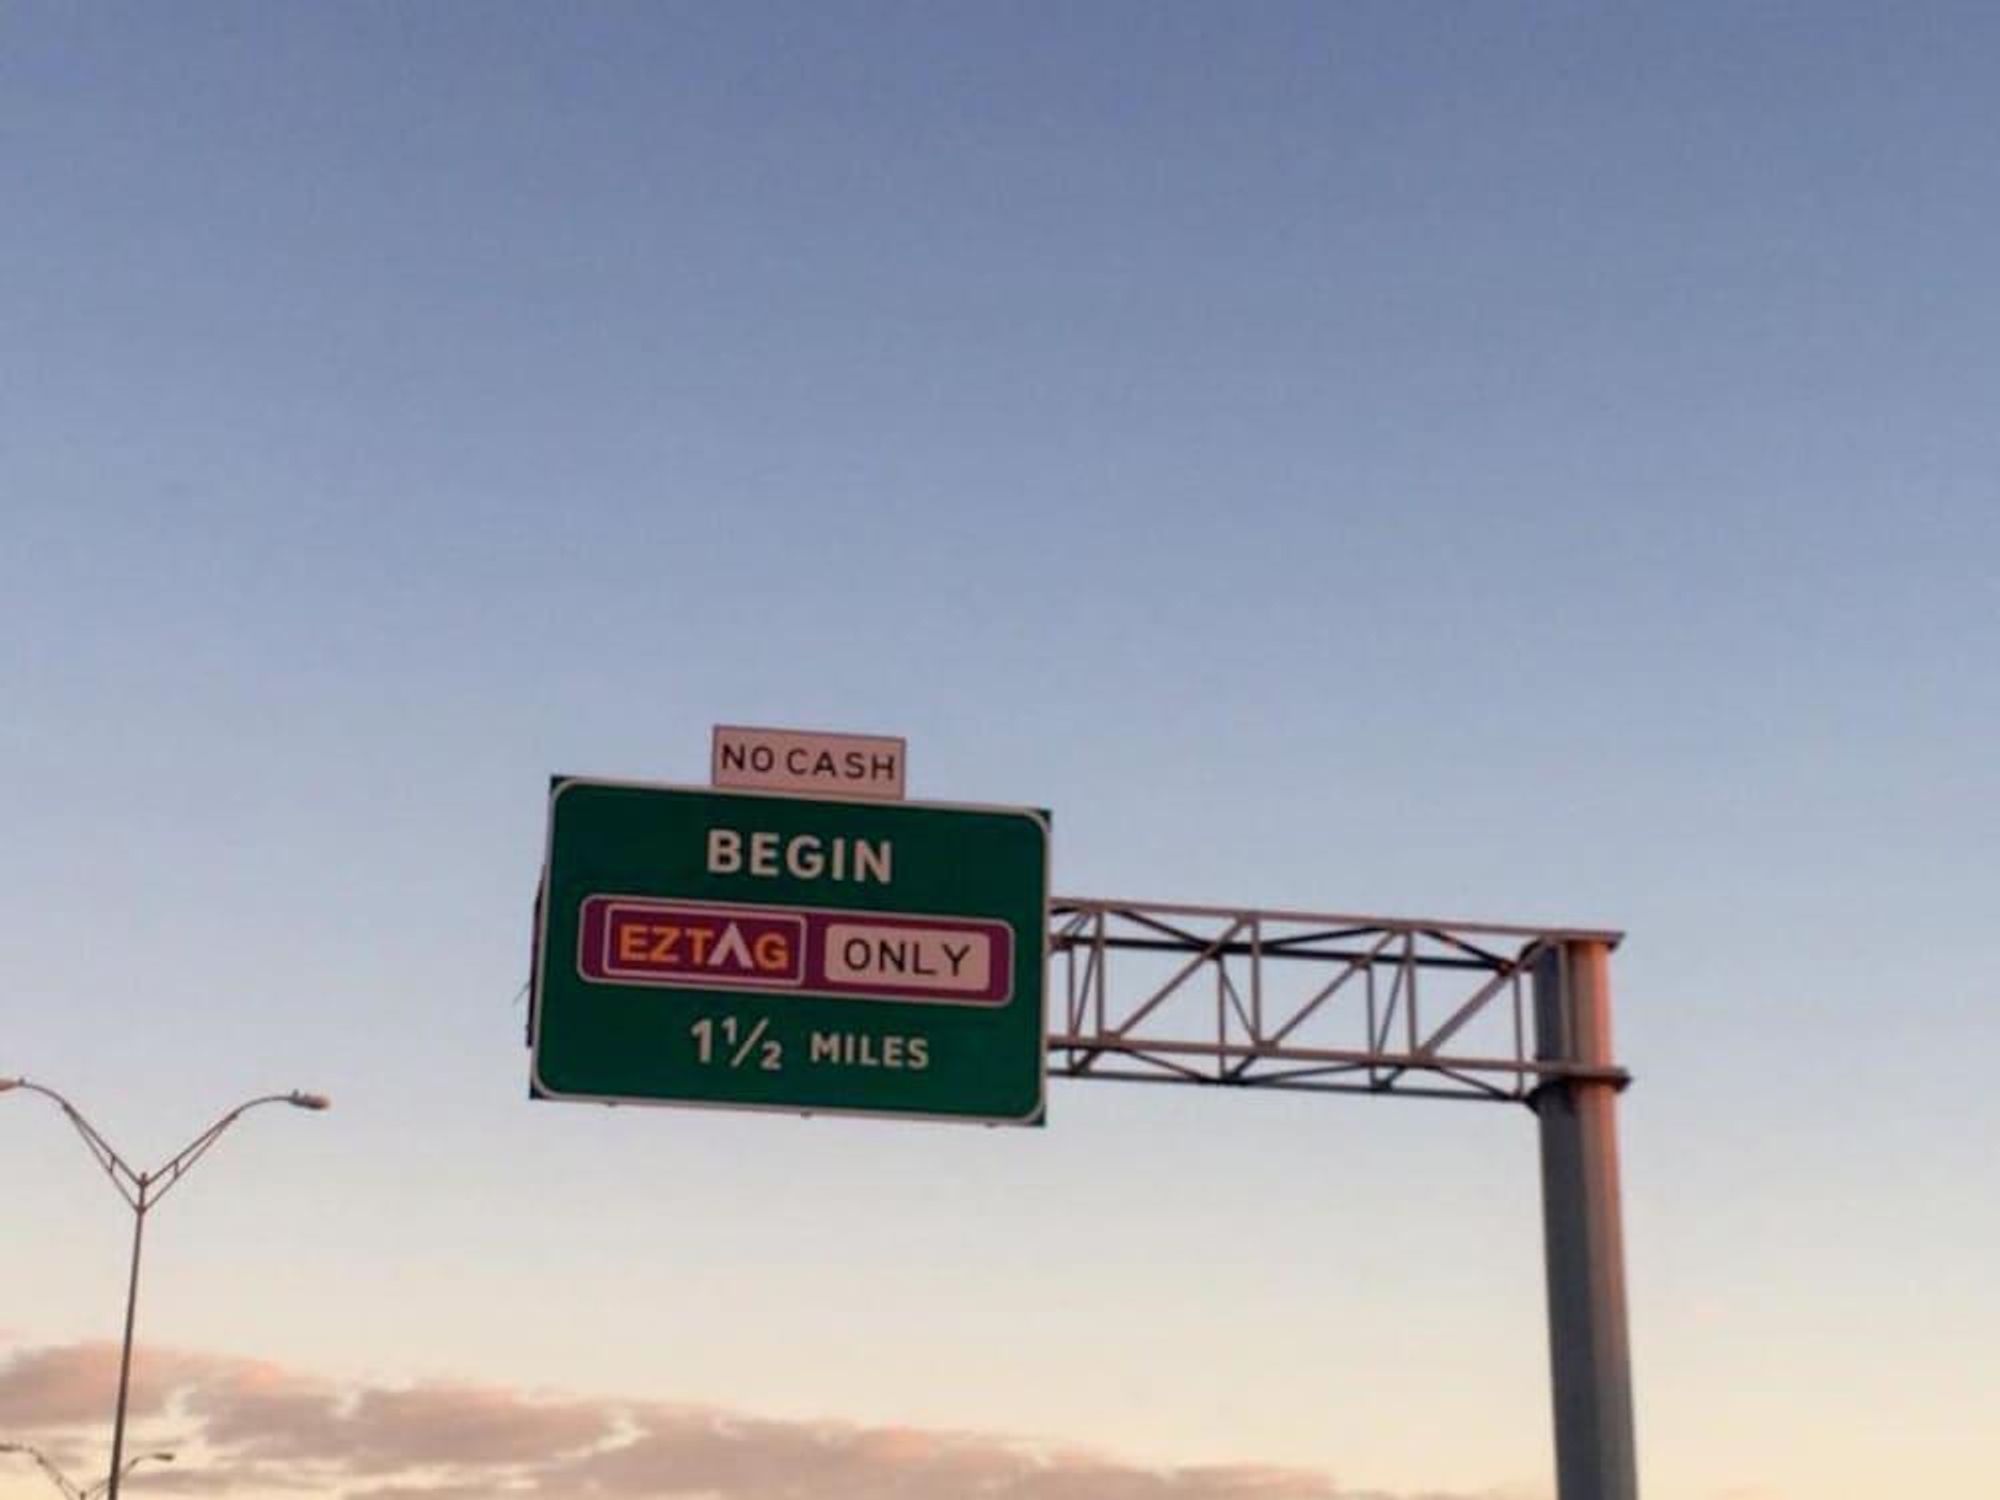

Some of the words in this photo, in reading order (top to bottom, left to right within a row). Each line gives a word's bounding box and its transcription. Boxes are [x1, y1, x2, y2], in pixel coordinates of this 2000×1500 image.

[721, 745, 775, 772] NO
[786, 748, 896, 781] CASH
[706, 828, 893, 885] BEGIN
[843, 938, 972, 977] ONLY
[810, 1031, 930, 1069] MILES
